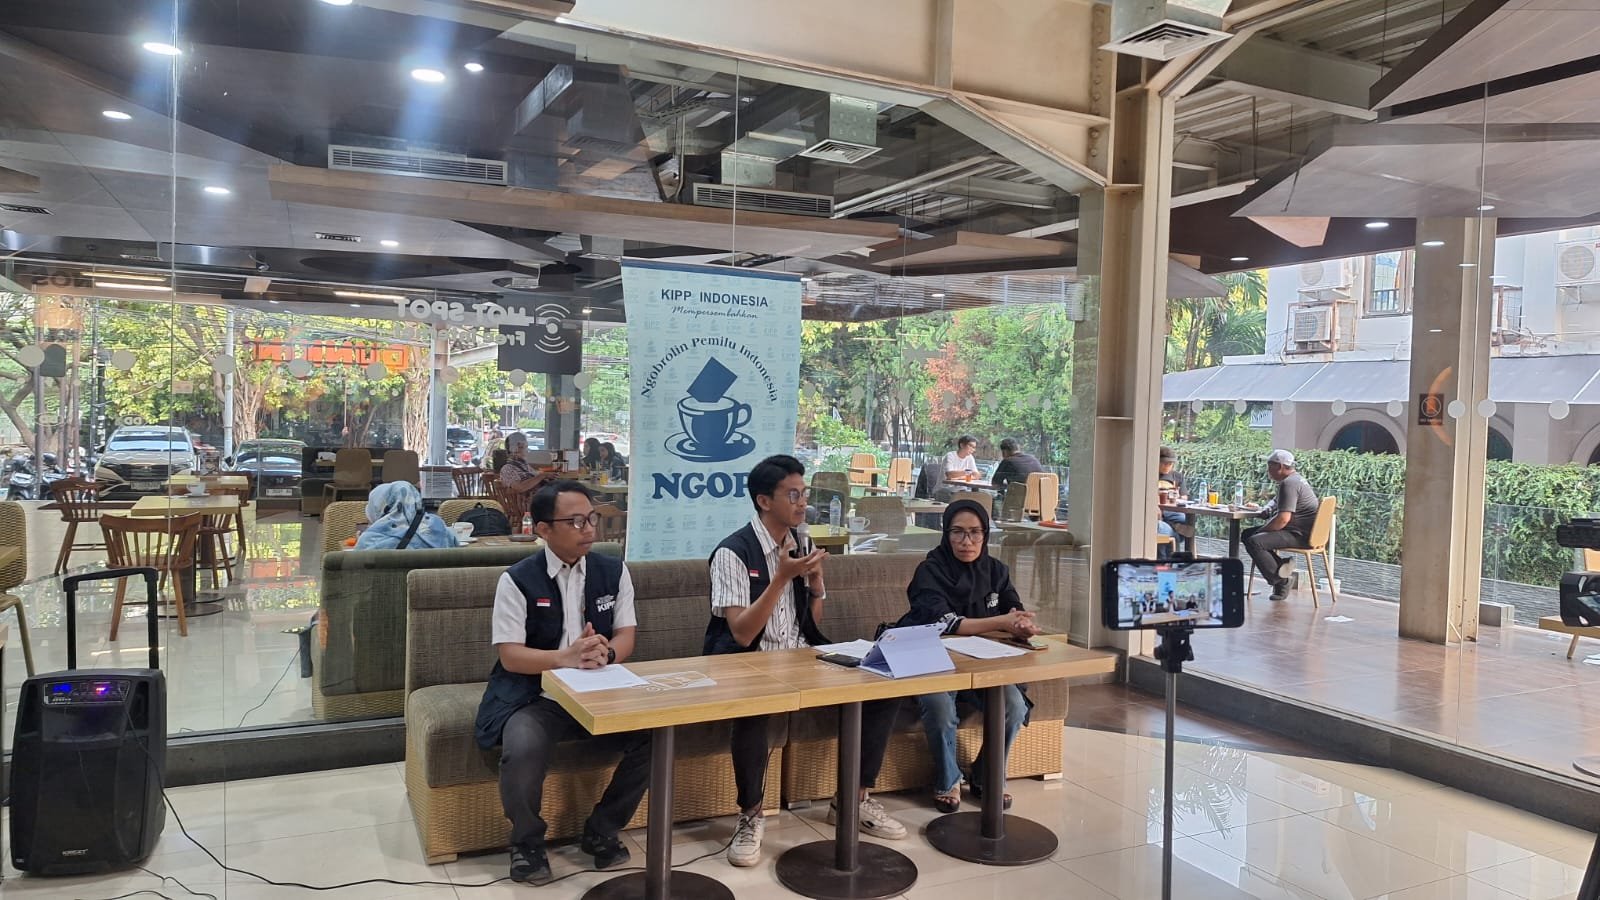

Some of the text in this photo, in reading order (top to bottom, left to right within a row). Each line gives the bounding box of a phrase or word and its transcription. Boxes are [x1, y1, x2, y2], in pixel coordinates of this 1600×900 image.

[661, 288, 769, 307] KIPP INDONESIA
[671, 306, 759, 319] Mempersembahkan
[640, 336, 779, 402] Ngobrolin Pemilu Indonesia
[652, 471, 752, 499] NGOP
